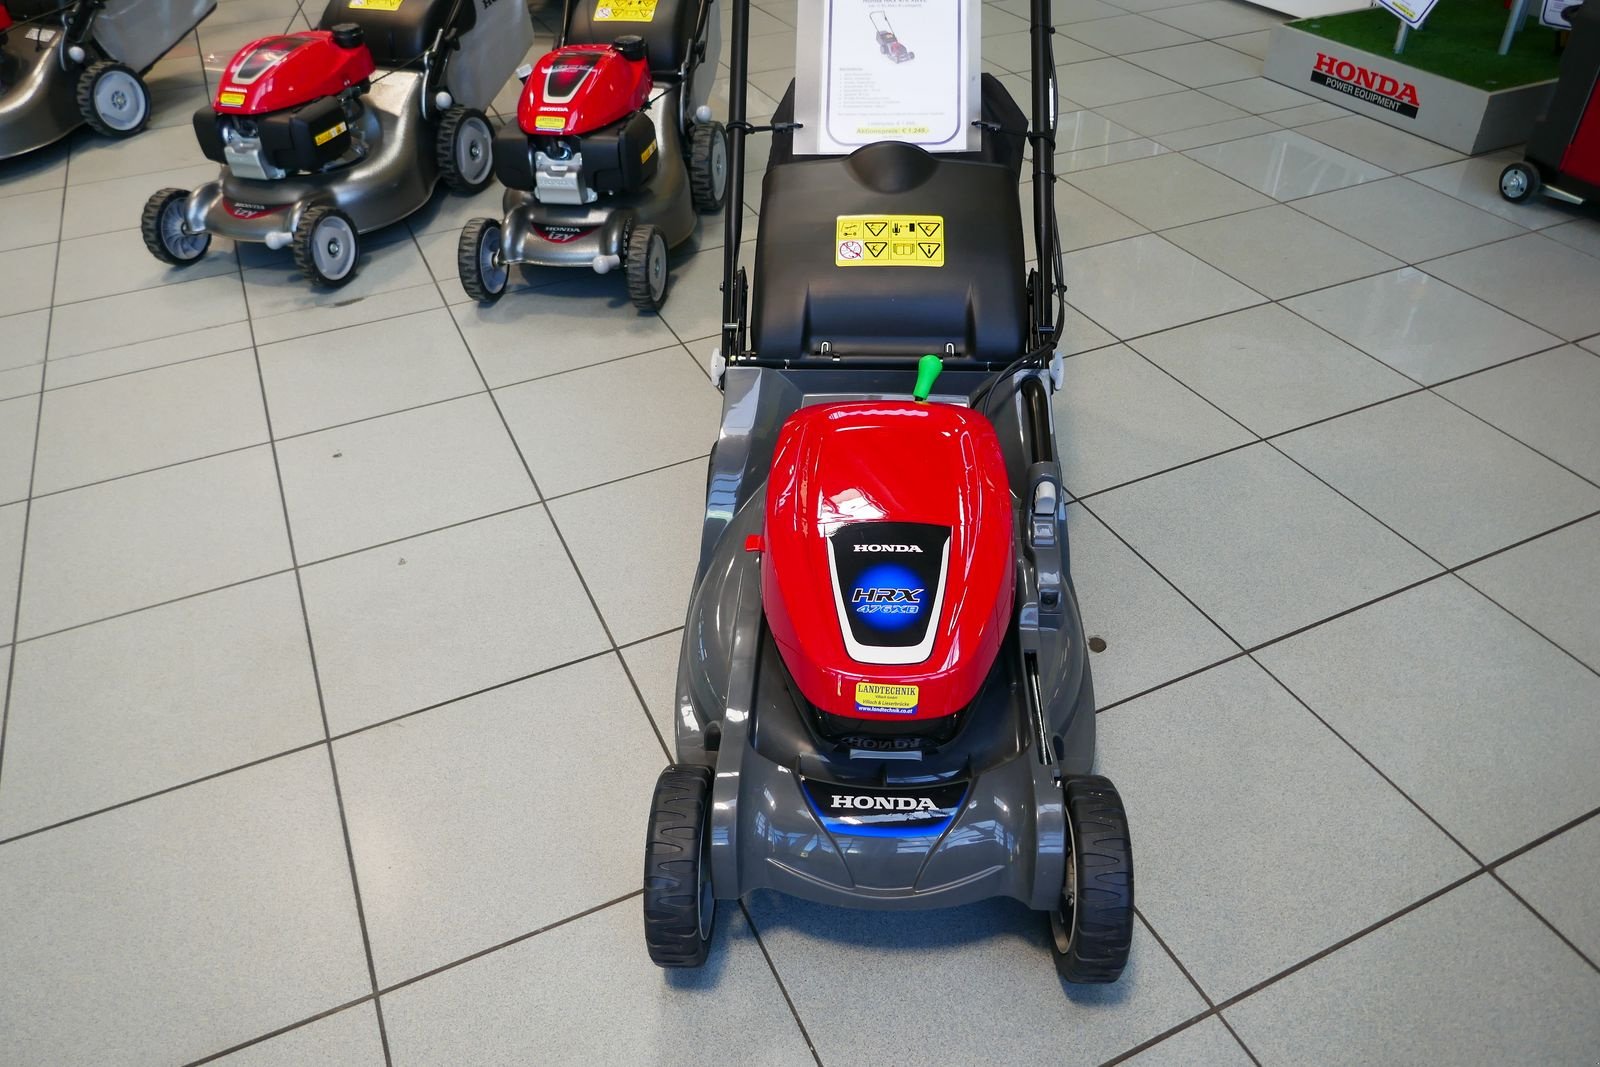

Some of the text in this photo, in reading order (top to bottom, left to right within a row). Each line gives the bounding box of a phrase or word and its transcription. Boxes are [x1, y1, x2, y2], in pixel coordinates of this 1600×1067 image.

[1313, 53, 1420, 106] HONDA
[1325, 77, 1402, 111] POWER EQUIPMENT
[853, 544, 923, 553] HONDA
[851, 588, 924, 604] HRX
[858, 684, 916, 696] LANDTECHNIK
[858, 706, 913, 714] www.landtechnik.co.at
[831, 795, 939, 810] HONDA
